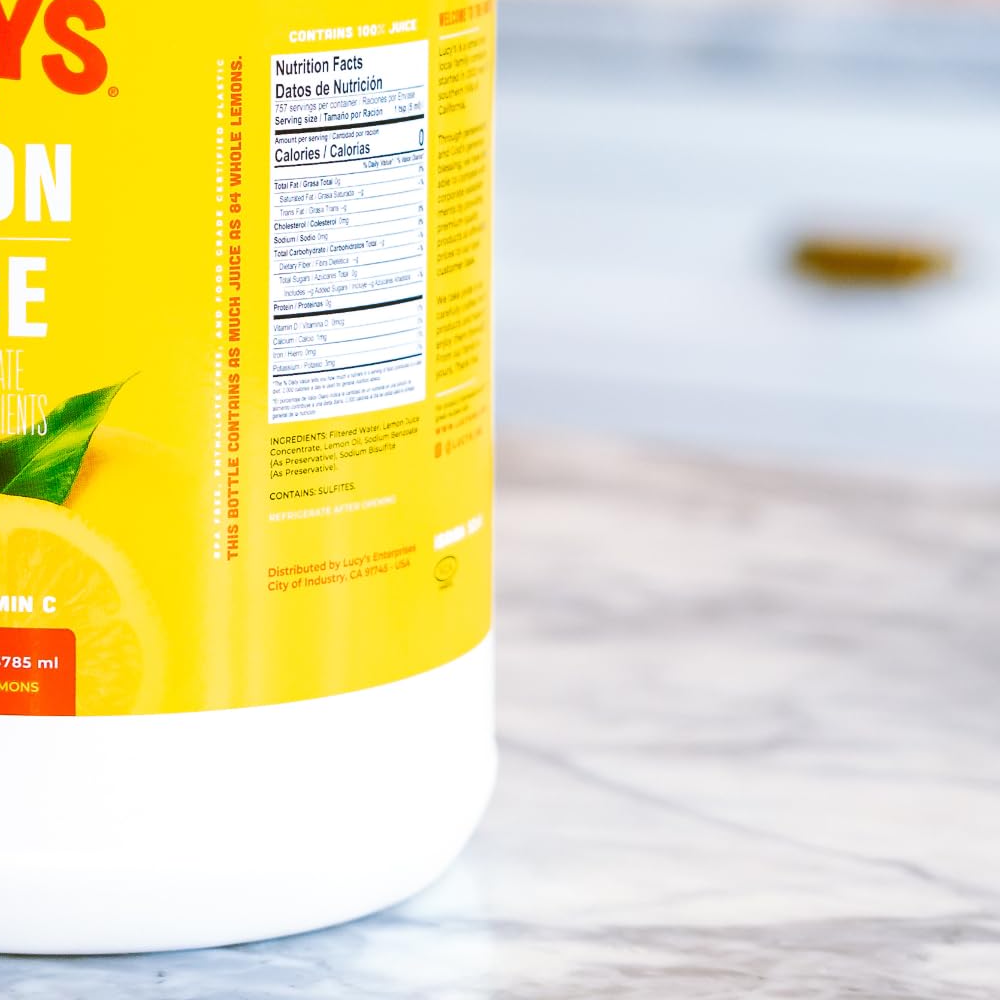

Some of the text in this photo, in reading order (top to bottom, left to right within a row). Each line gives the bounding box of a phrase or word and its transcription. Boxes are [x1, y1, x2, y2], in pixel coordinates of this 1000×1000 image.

[289, 26, 352, 43] CONTAINS
[389, 19, 417, 34] JUICE
[276, 55, 363, 75] Nutrition Facts
[216, 58, 224, 118] PLASTIC
[276, 75, 383, 98] Datos de Nutrición
[275, 104, 287, 113] 757
[290, 102, 317, 112] servings
[319, 102, 328, 110] per
[275, 116, 302, 125] Serving
[305, 114, 317, 123] size
[351, 111, 361, 120] por
[275, 136, 297, 144] Amount
[298, 135, 306, 143] per
[309, 132, 328, 142] serving
[419, 128, 424, 146] 0
[275, 147, 320, 162] Calories
[330, 141, 370, 157] Calorías
[275, 182, 288, 190] Total
[303, 179, 319, 188] Grasa
[274, 220, 306, 231] Cholesterol
[310, 218, 336, 228] Colesterol
[274, 235, 295, 244] Sodium
[300, 234, 316, 242] Sodio
[275, 249, 288, 257] Total
[289, 246, 326, 256] Carbohydrate
[227, 56, 242, 560] THIS BOTTLE CONTAINS AS MUCH JUICE AS 84 WHOLE LEMONS.
[274, 303, 293, 312] Protein
[271, 433, 326, 445] INGREDIENTS:
[329, 429, 357, 438] Filtered
[324, 441, 349, 450] Lemon
[270, 488, 316, 501] CONTAINS:
[268, 561, 326, 578] Distributed
[329, 559, 340, 571] by
[343, 554, 370, 567] Lucy's
[268, 579, 288, 592] City
[292, 577, 302, 589] of
[350, 569, 362, 579] CA
[42, 596, 56, 613] C
[37, 657, 58, 669] ml
